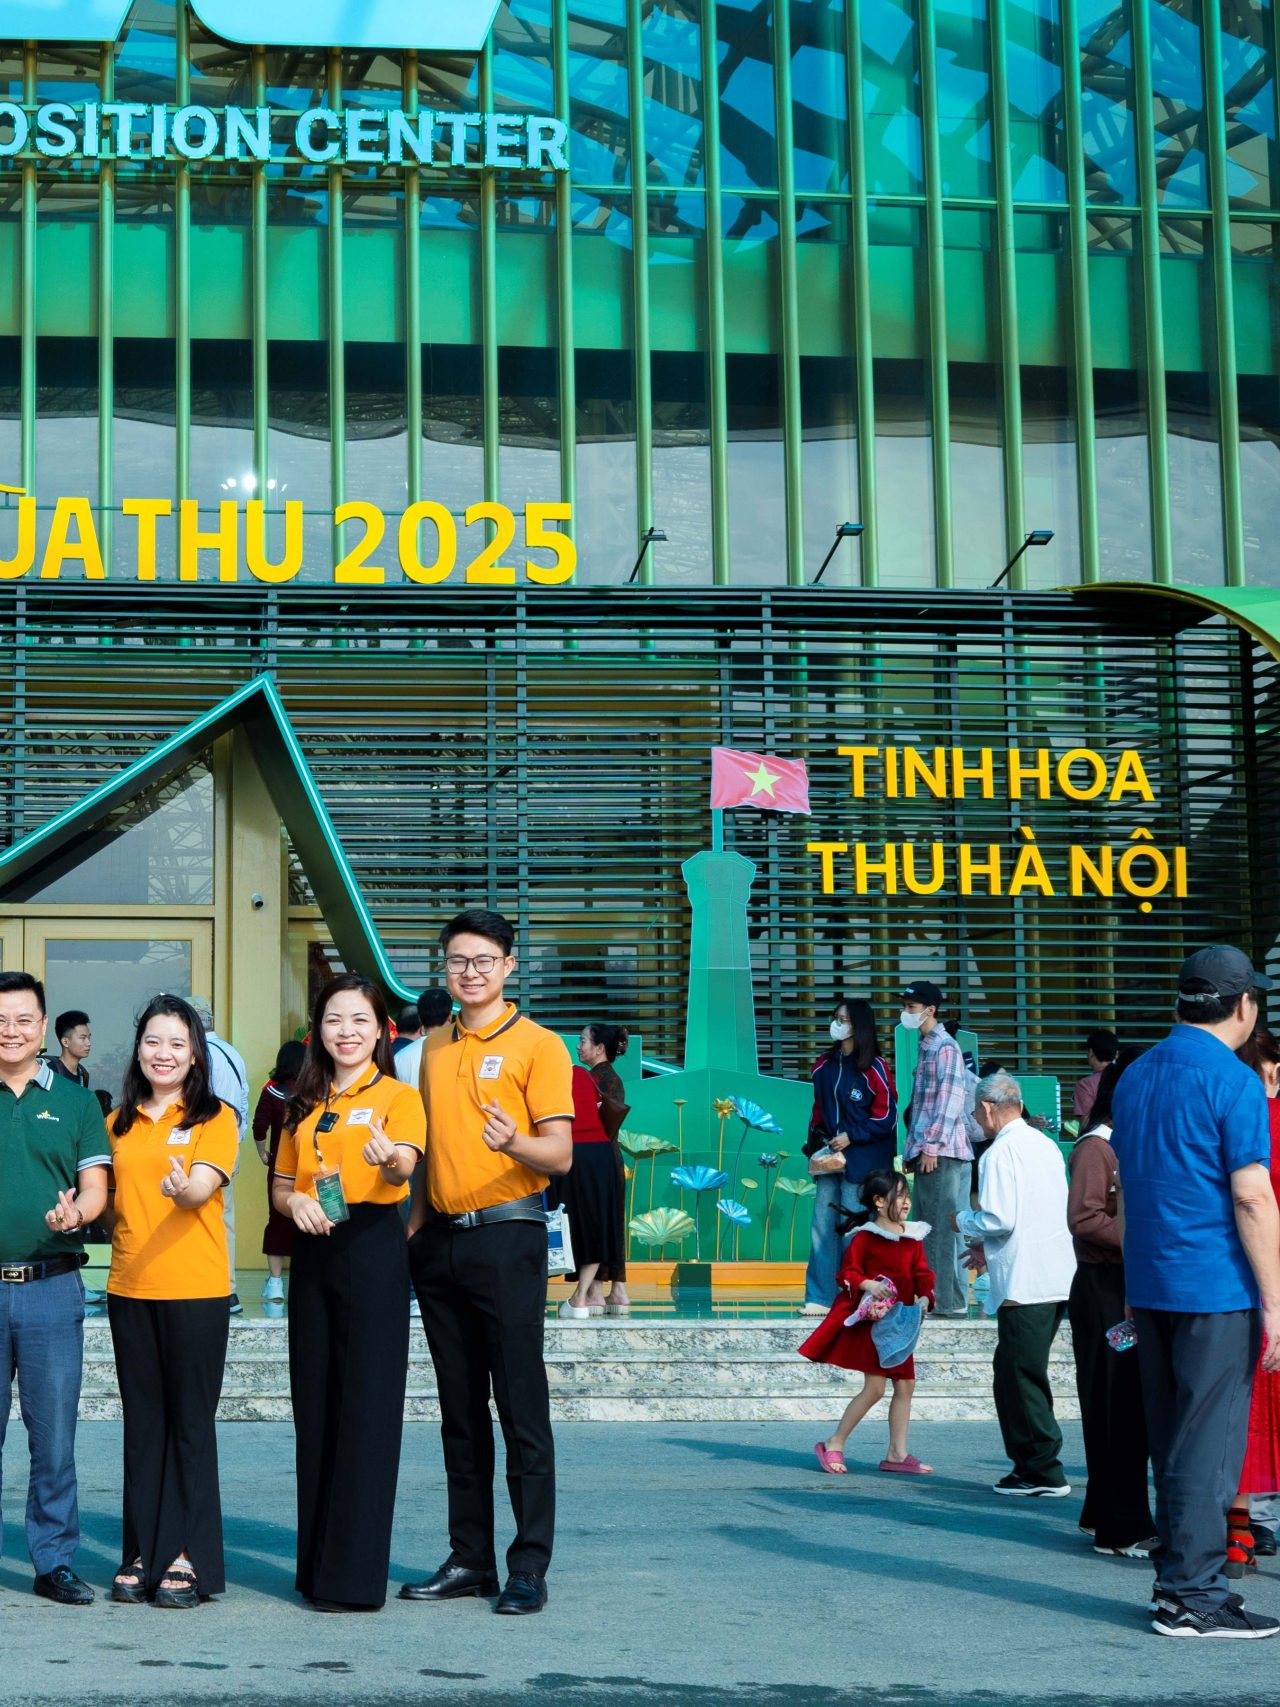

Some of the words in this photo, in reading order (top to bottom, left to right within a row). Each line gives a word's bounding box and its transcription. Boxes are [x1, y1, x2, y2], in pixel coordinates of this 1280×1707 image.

[294, 108, 570, 170] CENTER
[122, 498, 304, 584] THU
[333, 500, 577, 586] 2025
[837, 746, 994, 799] TINH
[1008, 748, 1156, 801] HOA
[806, 842, 945, 895] THU
[959, 826, 1055, 896] HÀ
[1071, 827, 1187, 913] NỘI
